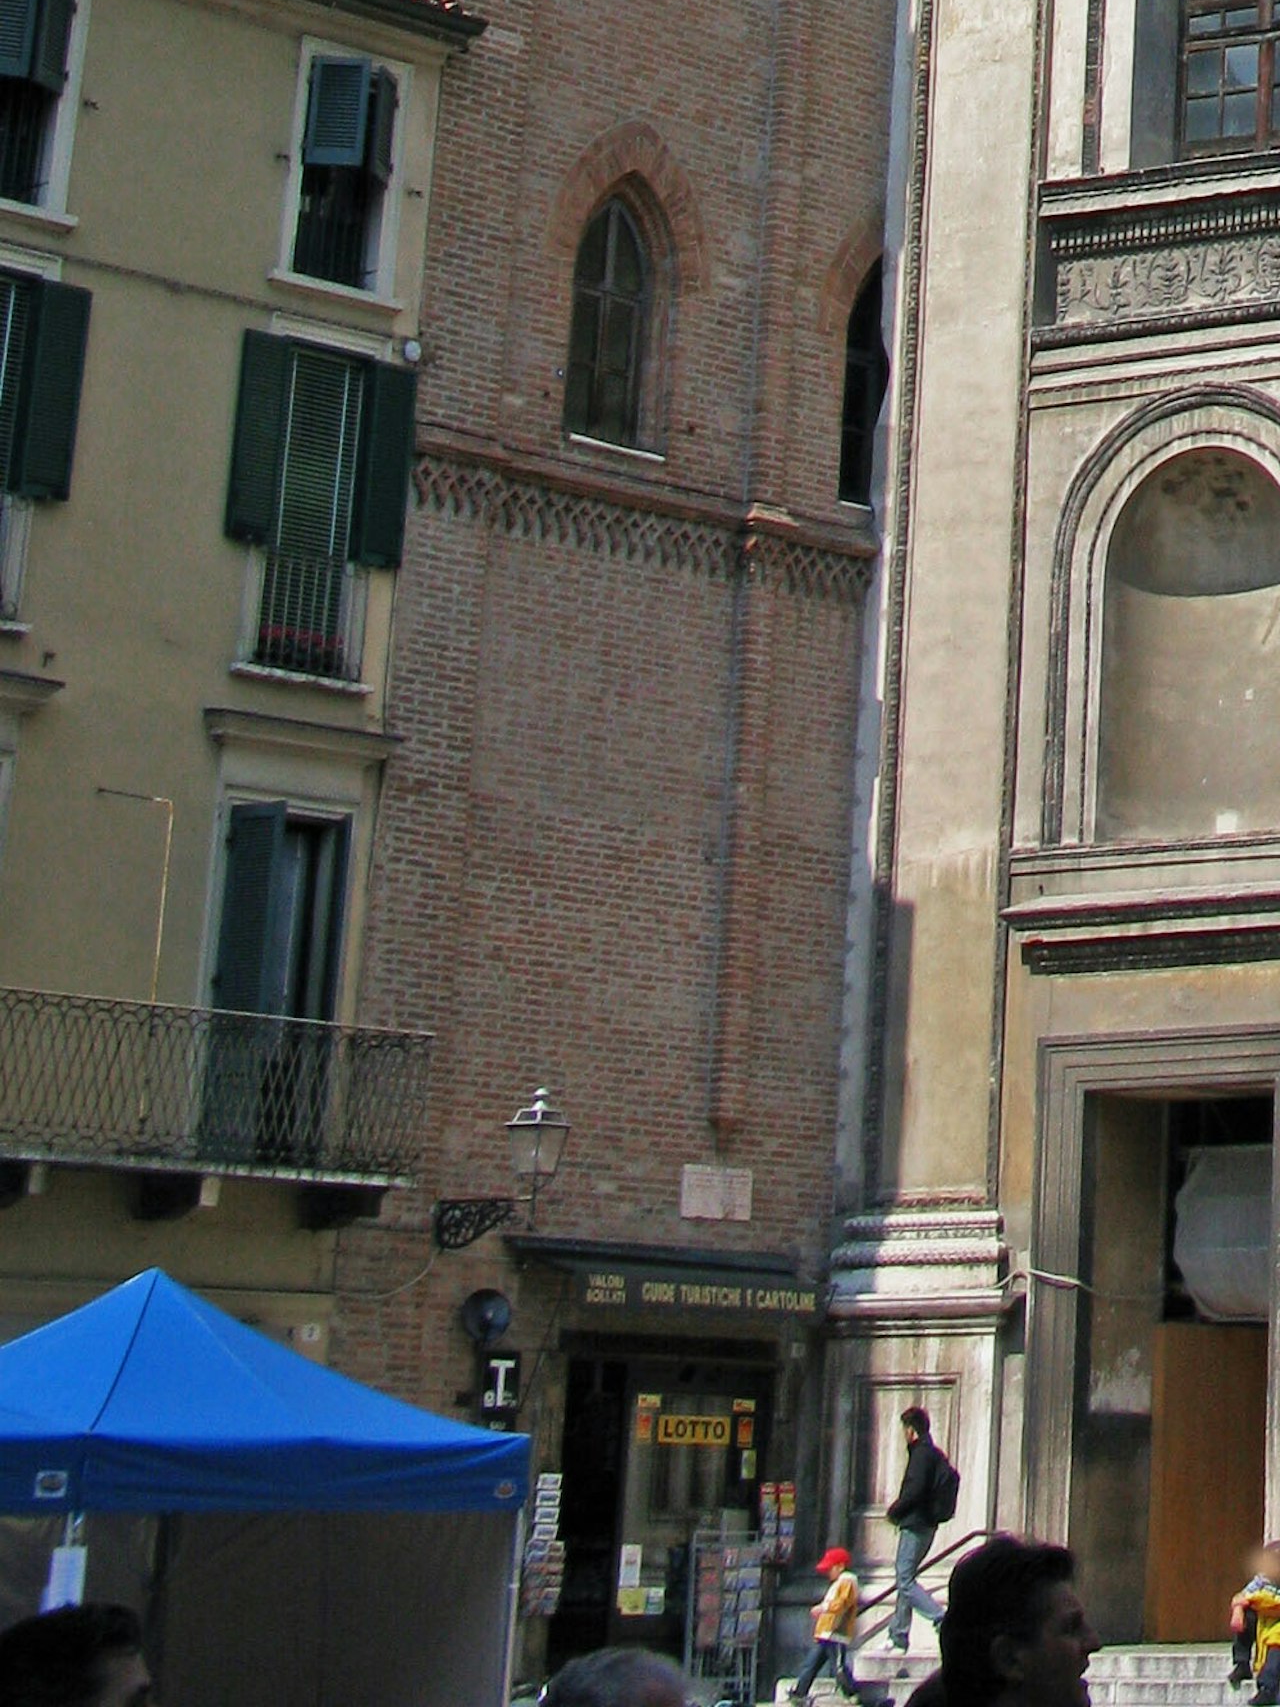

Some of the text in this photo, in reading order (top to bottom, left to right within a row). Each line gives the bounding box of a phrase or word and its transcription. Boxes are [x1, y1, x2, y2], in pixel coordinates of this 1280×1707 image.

[588, 1273, 625, 1289] VALORI
[642, 1281, 676, 1303] GUIDE
[680, 1284, 741, 1307] TURISTICHE
[756, 1289, 816, 1312] CARTOLINE
[663, 1418, 726, 1440] LOTTO
